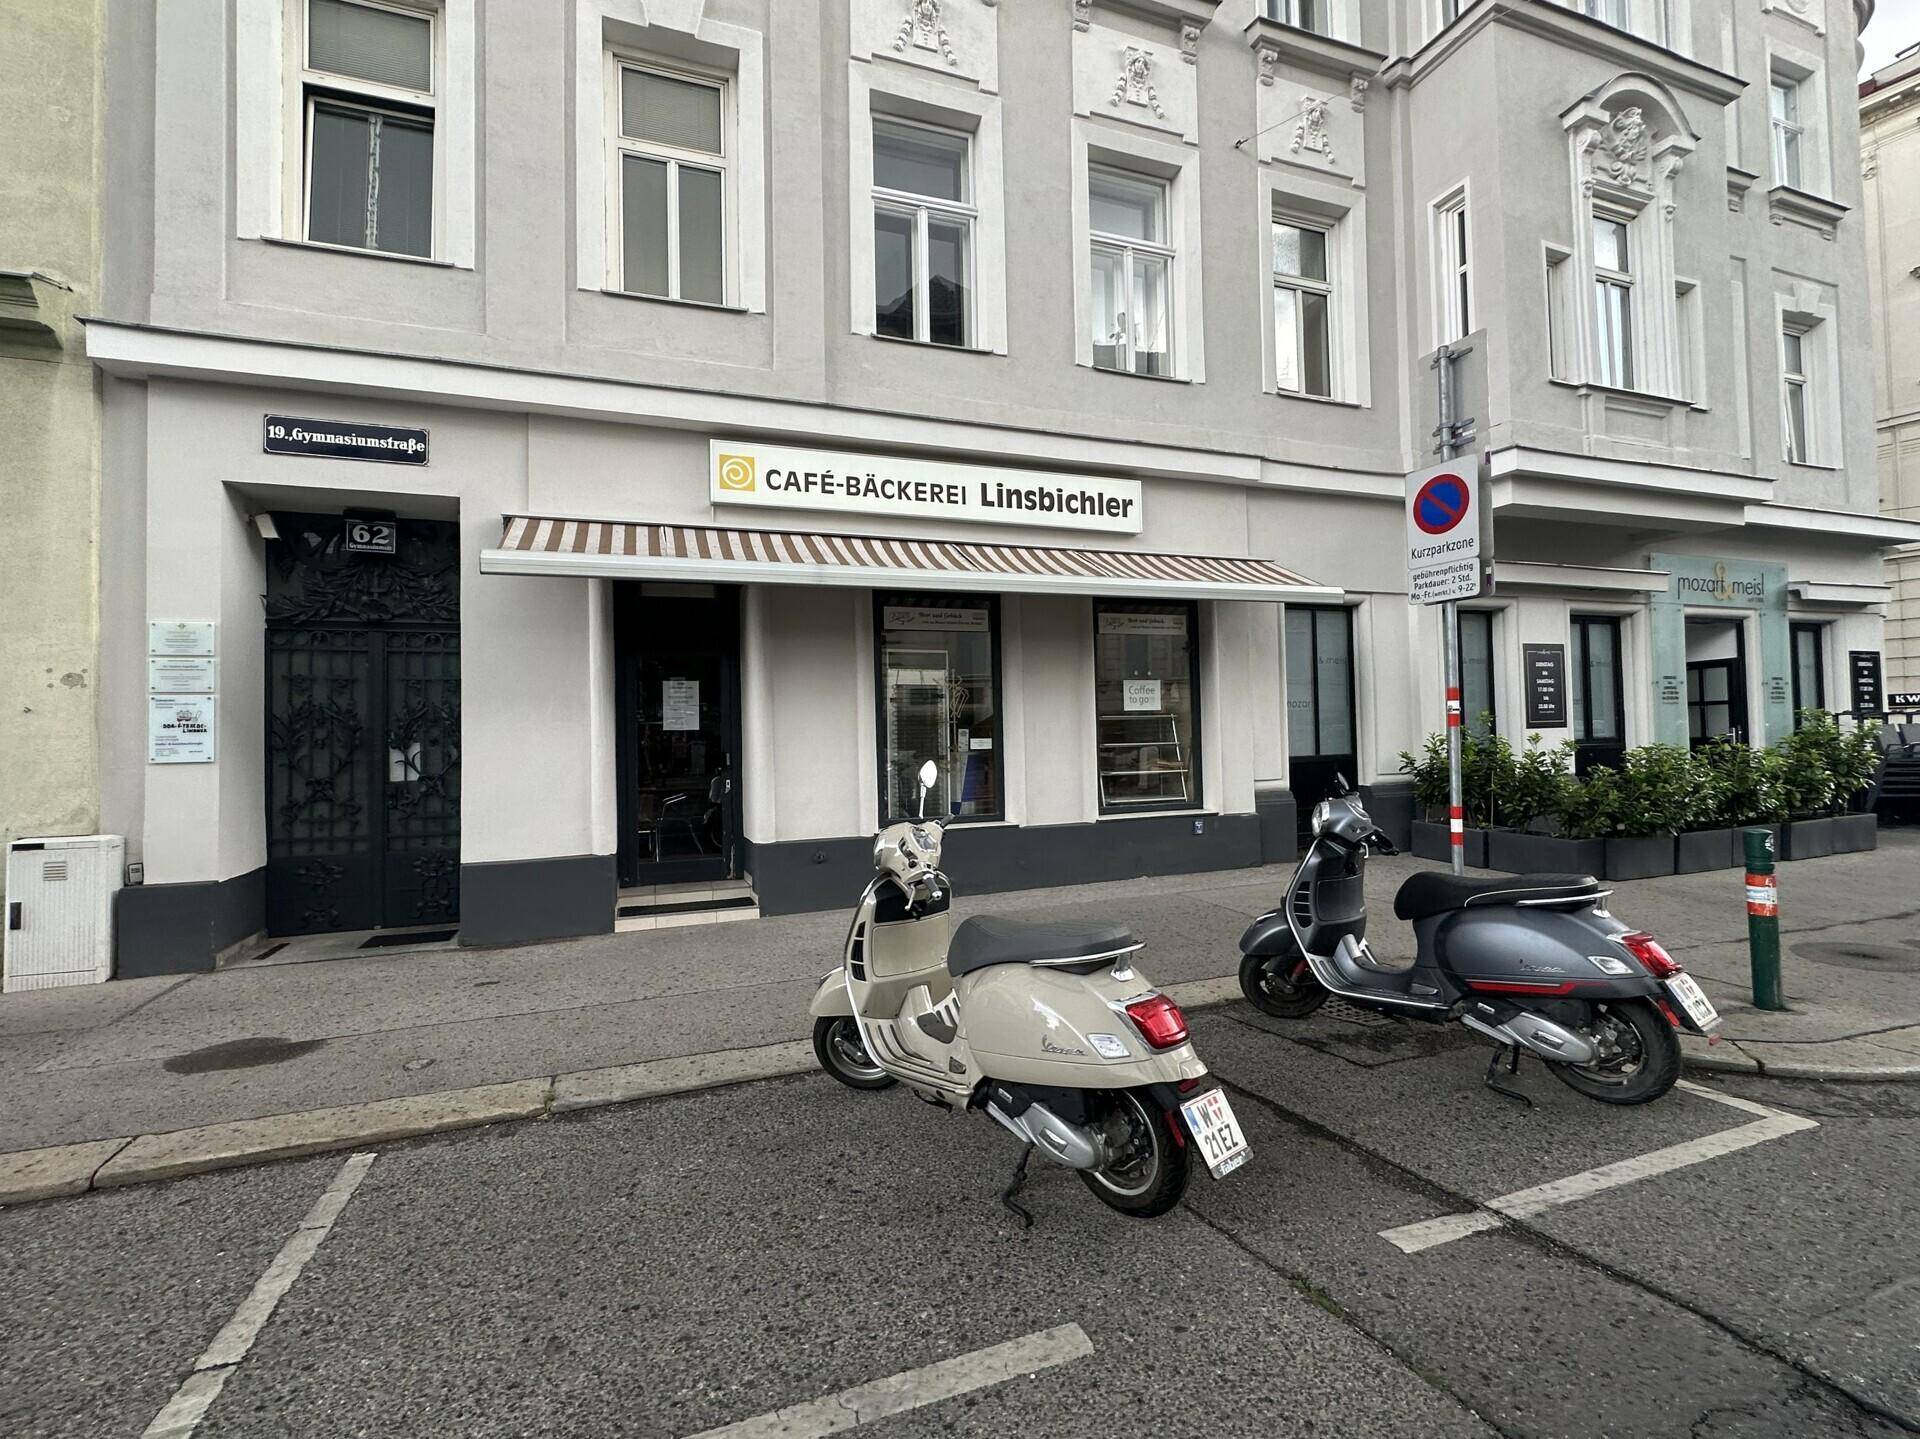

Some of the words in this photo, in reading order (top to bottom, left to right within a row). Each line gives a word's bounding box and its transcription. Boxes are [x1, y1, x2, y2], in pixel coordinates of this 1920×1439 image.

[765, 469, 967, 505] CAFÉ-BÄCKEREI
[980, 482, 1134, 518] Linsbichler
[352, 524, 390, 544] 62
[1411, 537, 1474, 560] Kurzparkzone
[1412, 562, 1474, 582] gebührenpflichtig
[1414, 578, 1450, 591] Parkdauer:
[1451, 576, 1456, 584] 2
[1457, 574, 1472, 583] Std.
[1732, 573, 1765, 596] meisl
[1128, 684, 1156, 695] Coffee
[1129, 696, 1138, 704] to
[1138, 696, 1150, 706] go
[1196, 1102, 1214, 1129] W
[1203, 1122, 1240, 1160] 21EZ
